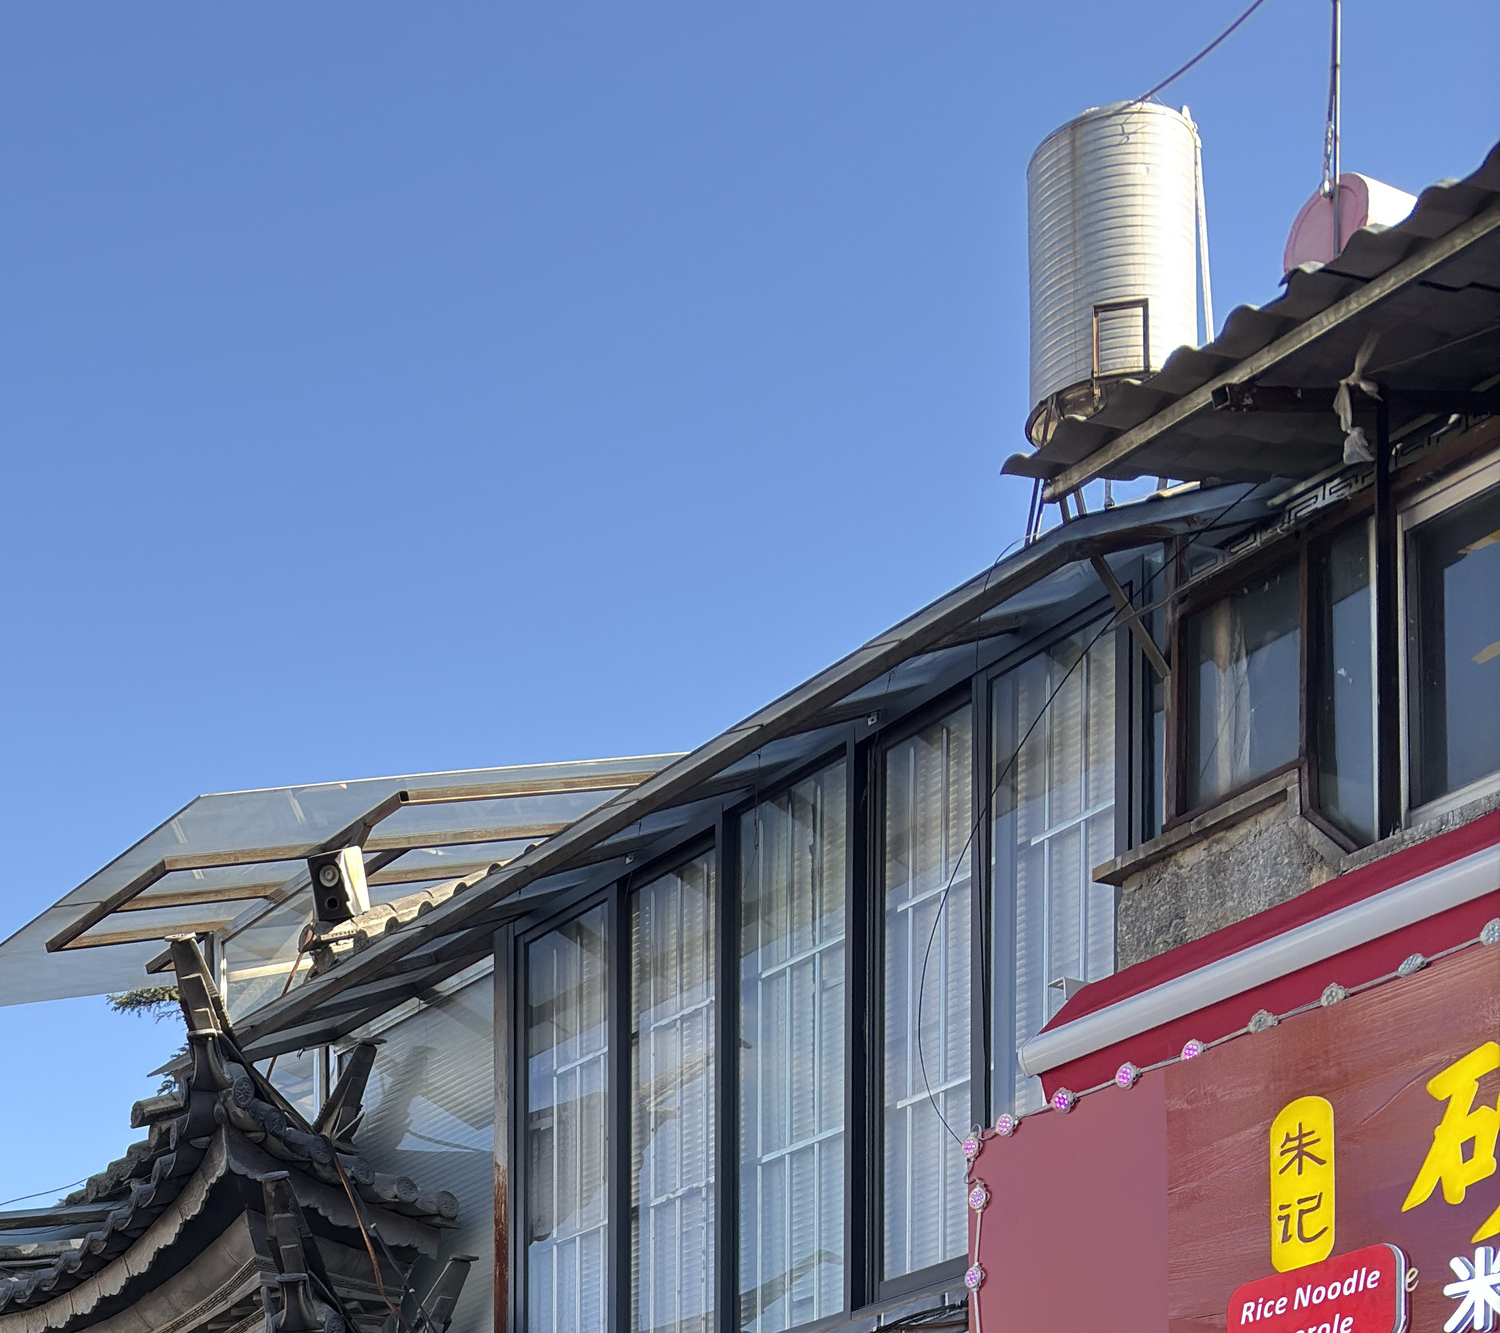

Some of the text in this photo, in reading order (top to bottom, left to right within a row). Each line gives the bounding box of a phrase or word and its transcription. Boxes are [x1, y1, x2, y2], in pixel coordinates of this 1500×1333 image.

[1277, 1121, 1329, 1244] 朱记
[1240, 1291, 1288, 1326] Rice
[1293, 1265, 1381, 1310] Noodle
